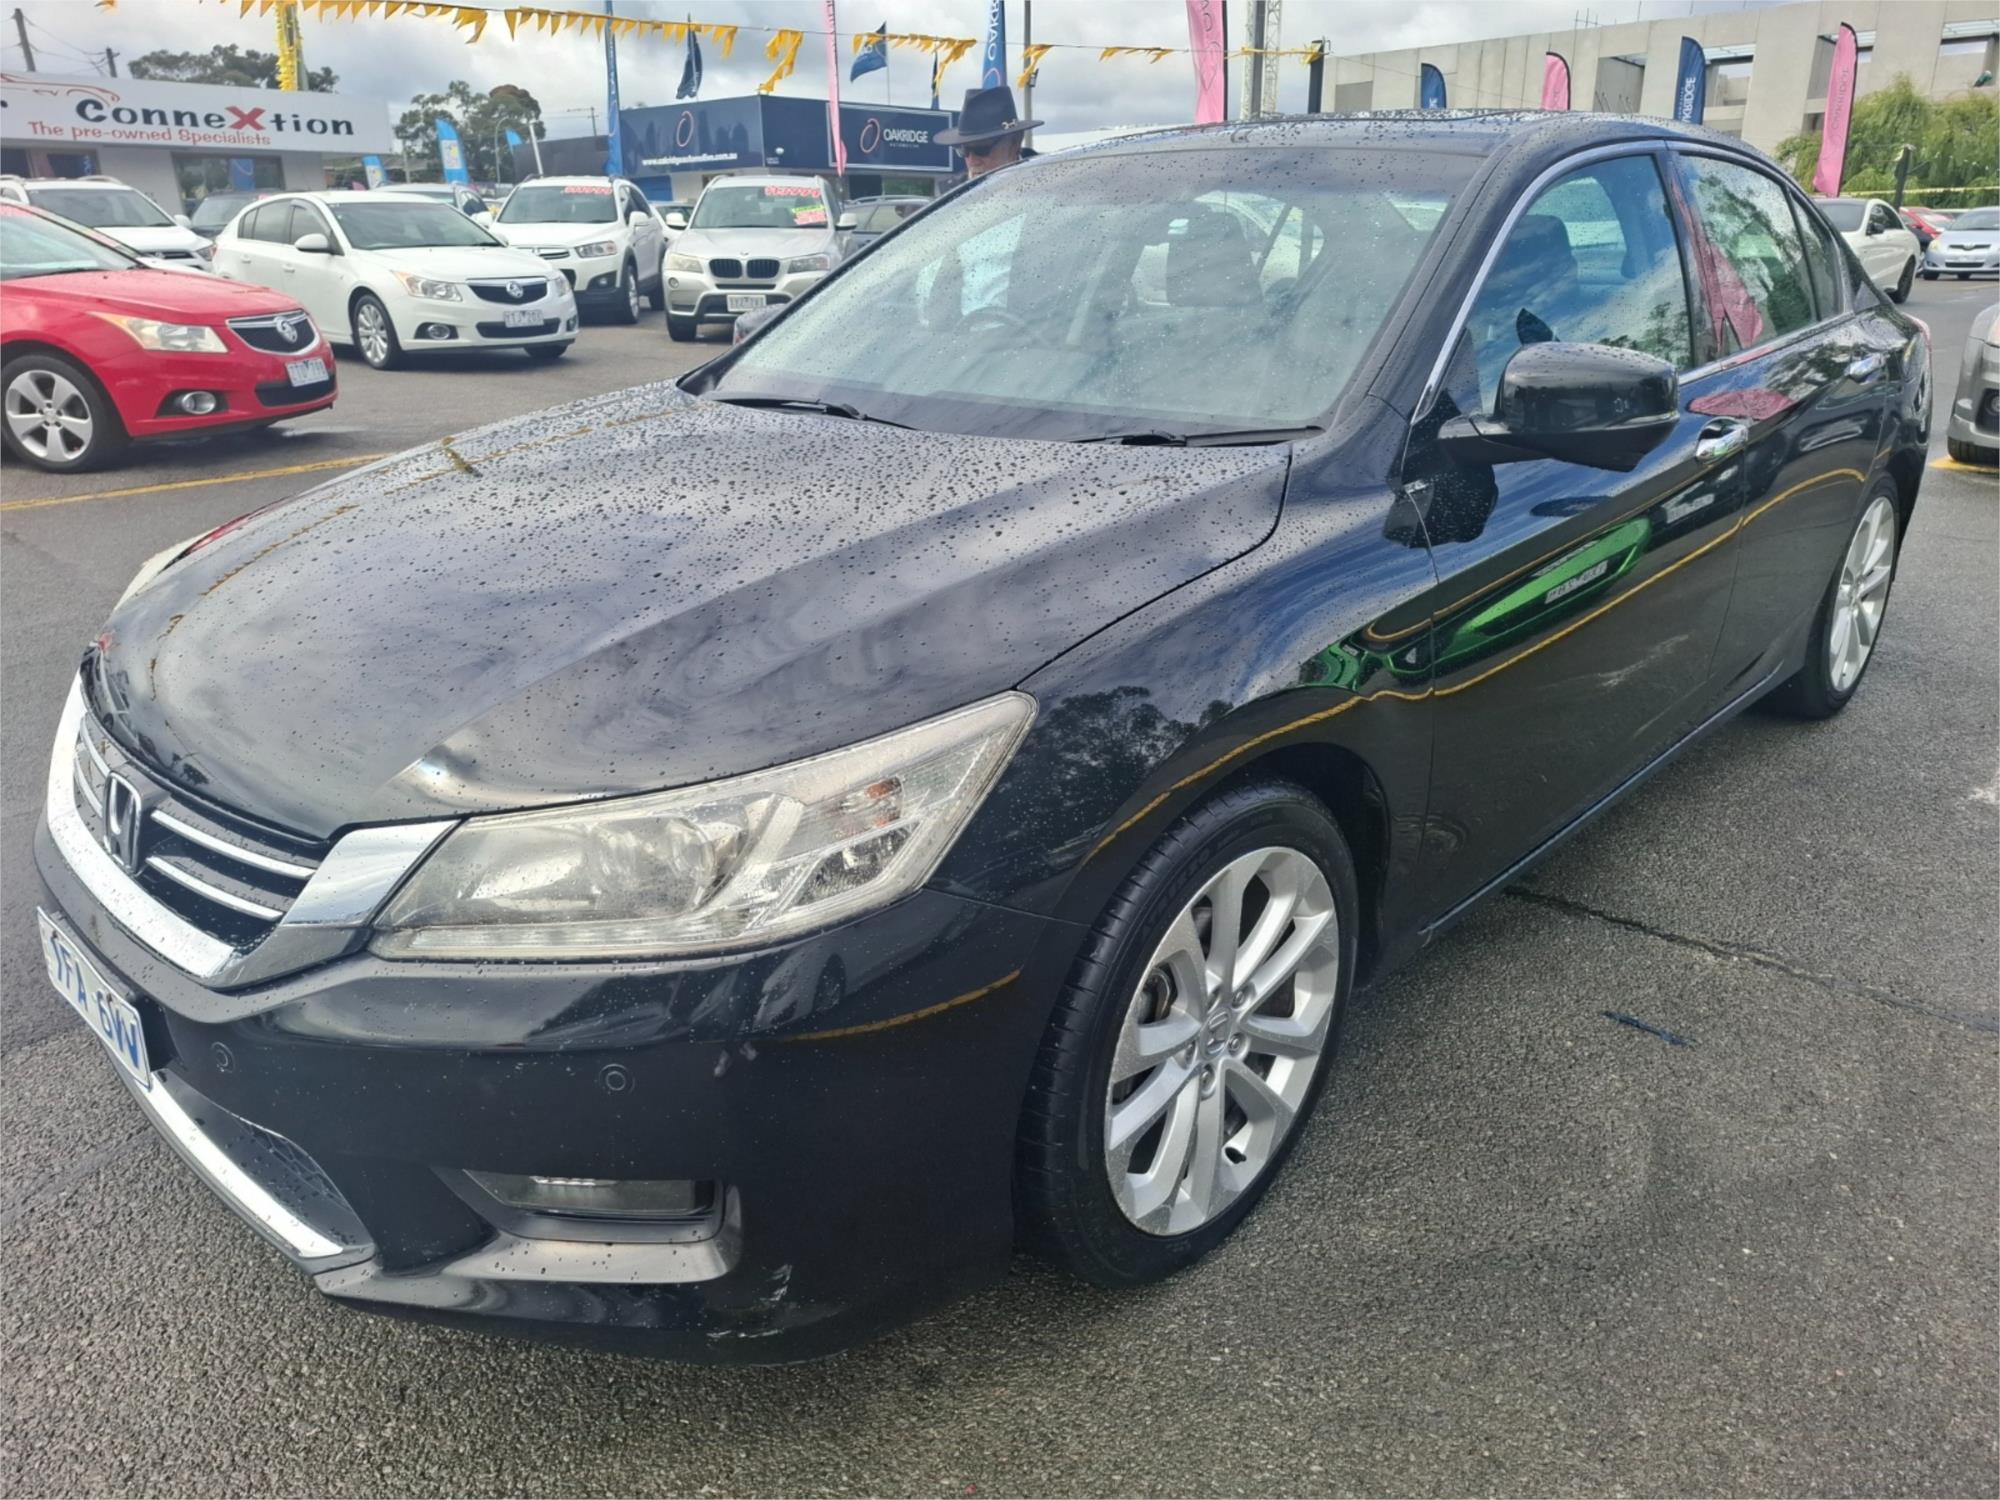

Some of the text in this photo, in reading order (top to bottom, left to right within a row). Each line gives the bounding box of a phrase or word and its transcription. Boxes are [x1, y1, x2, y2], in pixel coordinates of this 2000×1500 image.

[27, 121, 272, 147] The pre-owned Specialists
[883, 128, 928, 144] OAKRIDGE
